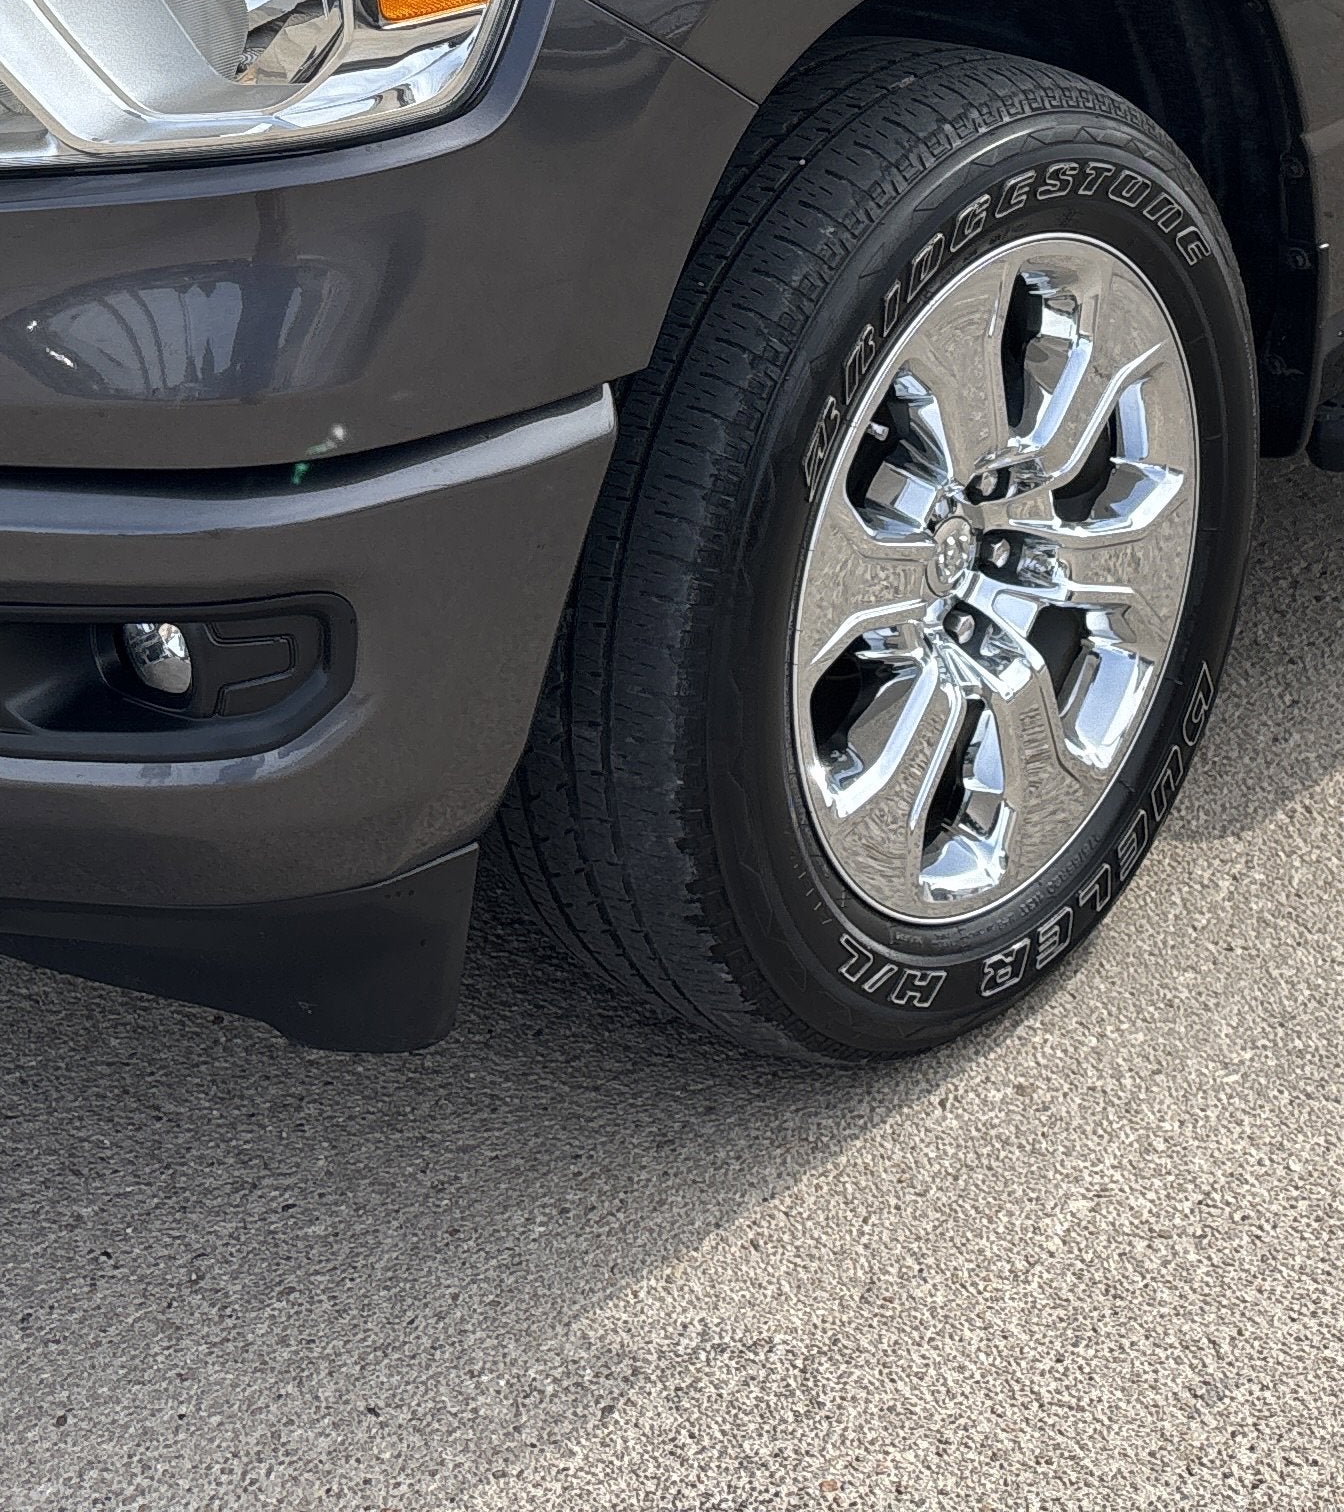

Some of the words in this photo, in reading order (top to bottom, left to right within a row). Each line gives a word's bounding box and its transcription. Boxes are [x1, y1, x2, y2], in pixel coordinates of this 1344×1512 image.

[801, 160, 1212, 504] BRIDGESTONE
[838, 933, 948, 1008] H/L
[979, 660, 1216, 997] DUELER
